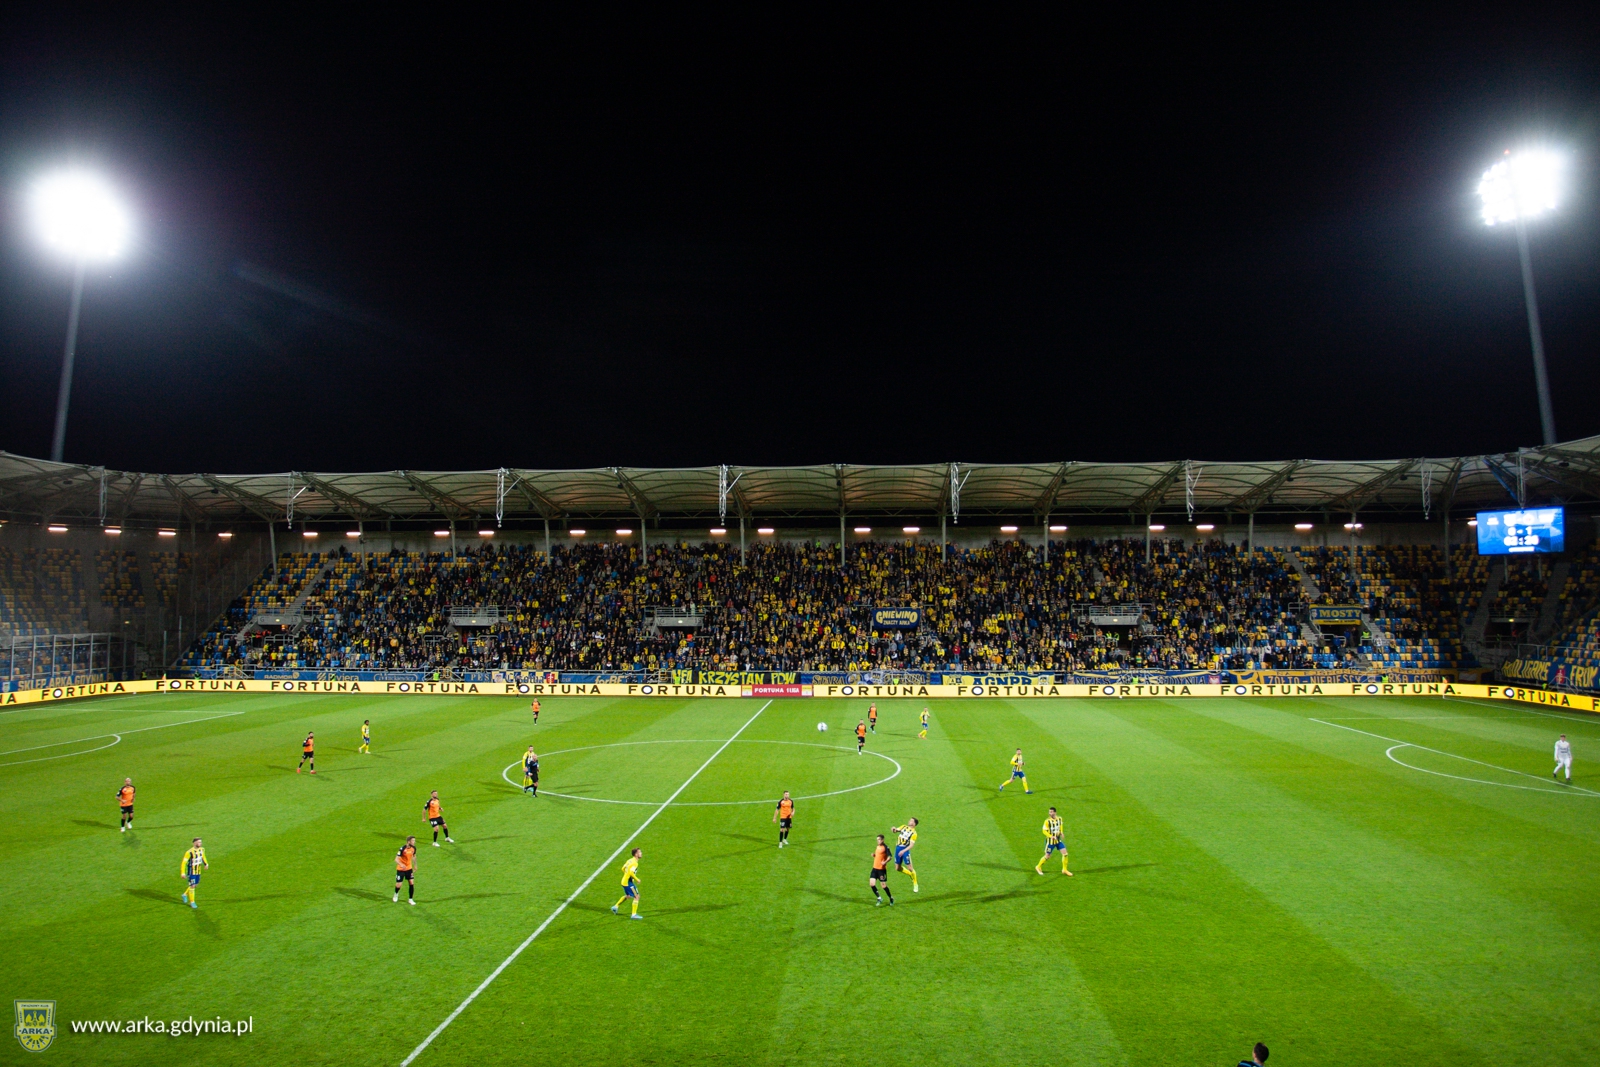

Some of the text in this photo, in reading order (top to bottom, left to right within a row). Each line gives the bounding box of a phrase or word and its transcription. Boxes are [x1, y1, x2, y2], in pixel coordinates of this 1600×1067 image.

[876, 611, 918, 624] GNIEWINO
[1320, 609, 1361, 617] MOSTY
[699, 671, 764, 685] KRZYSTAN
[41, 682, 125, 700] FORTUNA
[156, 681, 727, 695] FORTUNA FORTUNA FORTUNA FORTUNA FORTUNA
[828, 686, 929, 696] FORTUNA
[958, 686, 1060, 696] FORTUNA
[1089, 685, 1191, 695] FORTUNA
[1220, 685, 1323, 695] FORTUNA
[1488, 686, 1570, 706] FORTUNA
